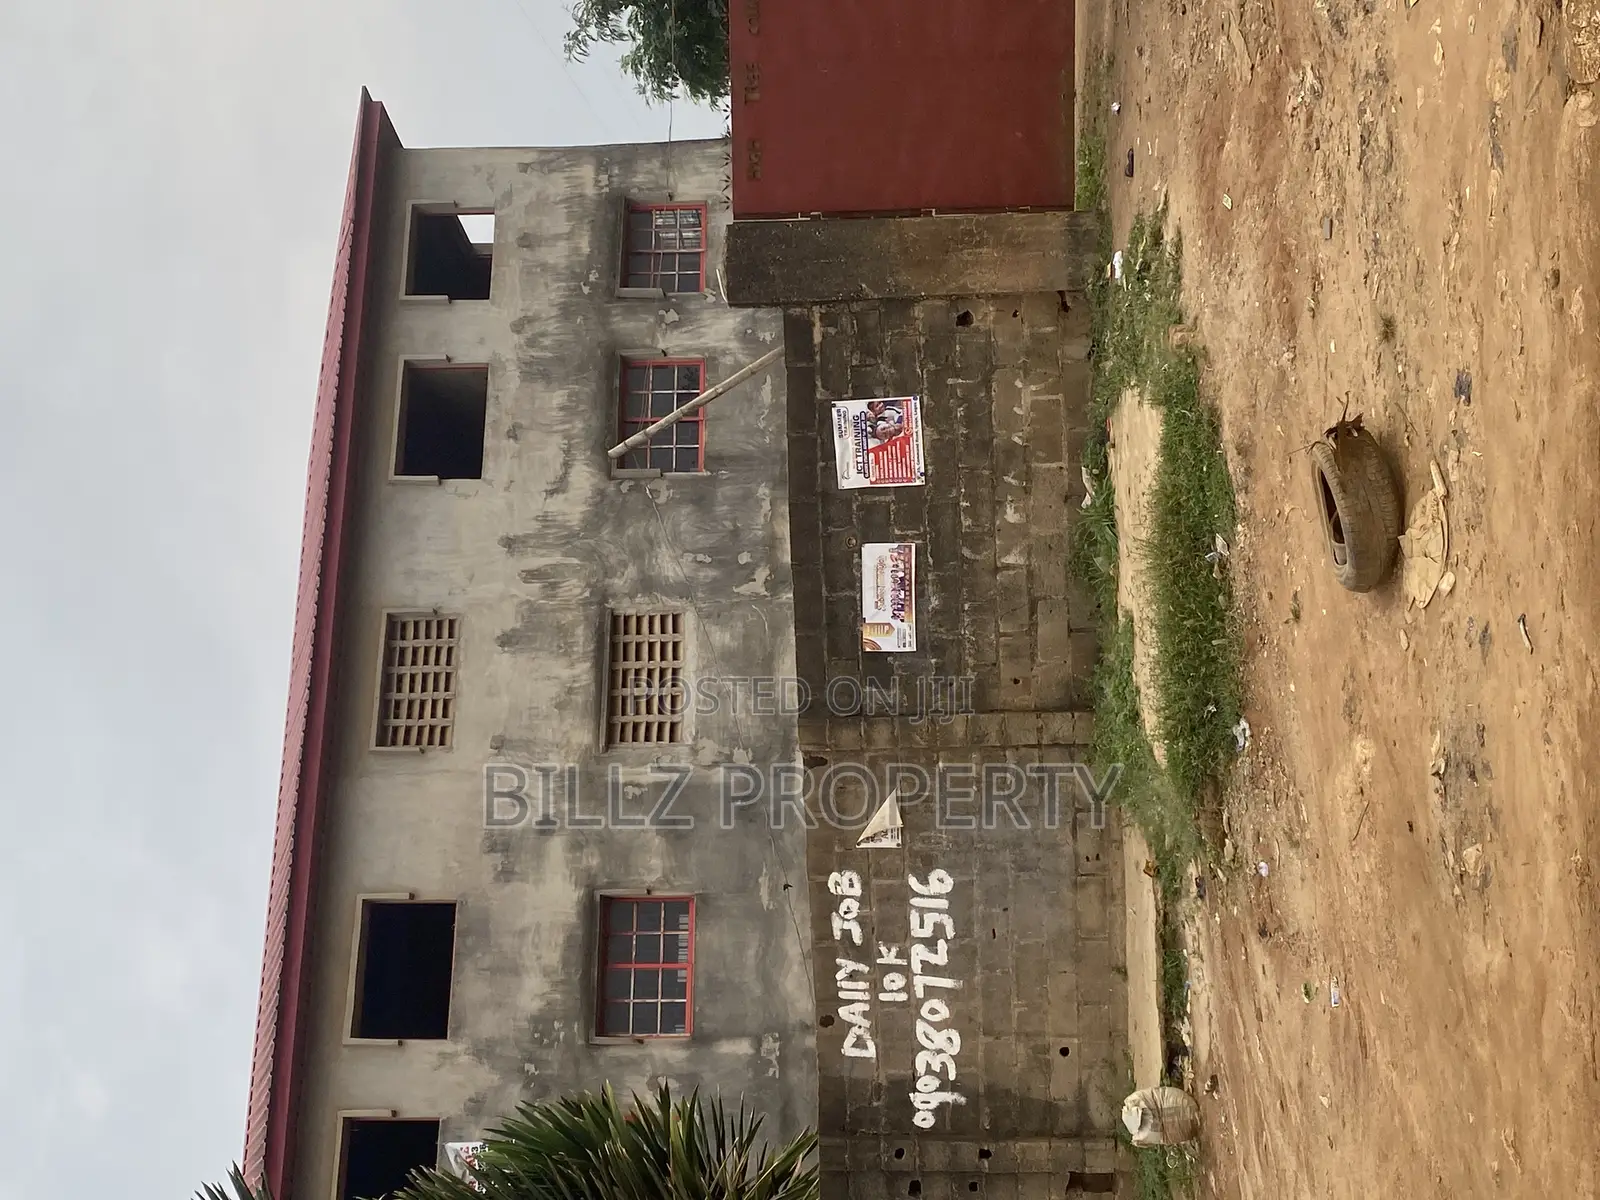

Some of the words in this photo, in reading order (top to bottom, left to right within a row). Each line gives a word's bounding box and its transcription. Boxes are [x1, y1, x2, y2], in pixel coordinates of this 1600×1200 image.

[853, 414, 862, 458] TRAINING
[827, 869, 863, 946] JOB
[908, 868, 967, 1129] 09038072516
